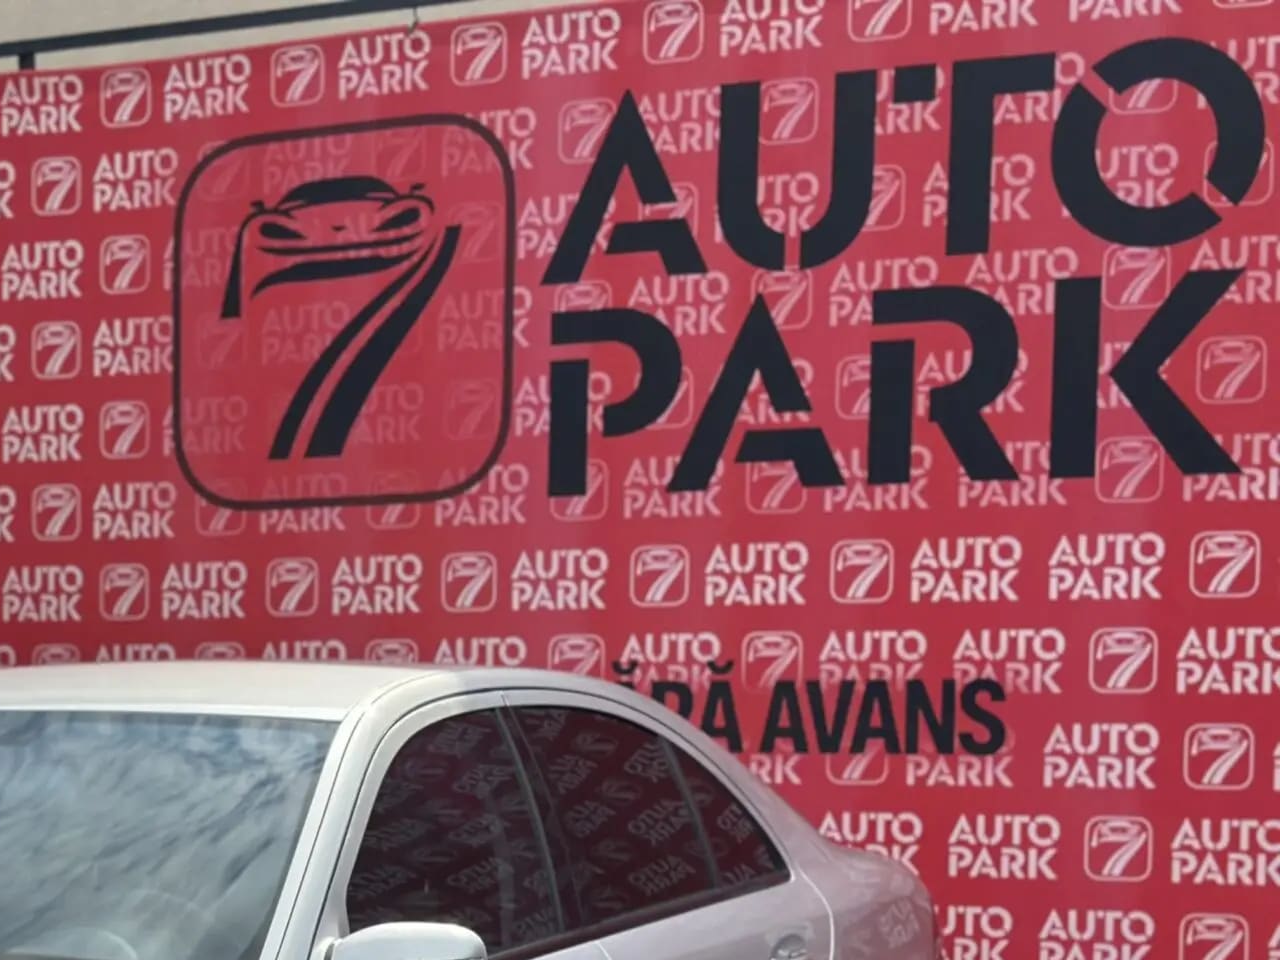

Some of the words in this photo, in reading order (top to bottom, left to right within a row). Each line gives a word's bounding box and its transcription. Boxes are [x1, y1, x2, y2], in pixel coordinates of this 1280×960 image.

[522, 5, 621, 46] AUTO
[929, 0, 1038, 35] PARK
[338, 27, 431, 67] AUTO
[721, 17, 821, 56] PARK
[163, 51, 251, 91] AUTO
[522, 39, 618, 79] PARK
[1, 71, 83, 105] AUTO
[339, 59, 428, 99] PARK
[164, 83, 248, 122] PARK
[1, 103, 81, 136] PARK
[93, 148, 177, 182] AUTO
[541, 37, 1266, 284] AUTO
[94, 179, 174, 212] PARK
[1, 240, 83, 272] AUTO
[965, 247, 1078, 284] AUTO
[2, 268, 80, 300] PARK
[629, 271, 729, 306] AUTO
[830, 256, 938, 294] AUTO
[93, 316, 172, 348] AUTO
[94, 346, 172, 376] PARK
[548, 269, 1244, 496] PARK
[2, 404, 83, 434] AUTO
[3, 433, 80, 462] PARK
[93, 483, 175, 511] AUTO
[824, 481, 928, 511] PARK
[958, 477, 1066, 508] PARK
[94, 511, 173, 539] PARK
[260, 504, 346, 533] PARK
[436, 497, 526, 527] PARK
[511, 548, 608, 580] AUTO
[705, 541, 808, 575] AUTO
[911, 536, 1022, 570] AUTO
[1049, 532, 1165, 567] AUTO
[3, 566, 83, 593] AUTO
[162, 562, 247, 590] AUTO
[332, 554, 422, 585] AUTO
[911, 569, 1018, 602] PARK
[1049, 566, 1161, 600] PARK
[163, 590, 244, 619] PARK
[332, 584, 419, 614] PARK
[512, 579, 605, 611] PARK
[705, 573, 805, 606] PARK
[3, 594, 80, 620] PARK
[434, 637, 527, 667] AUTO
[620, 632, 721, 664] AUTO
[820, 630, 928, 662] AUTO
[953, 628, 1065, 662] AUTO
[761, 679, 1007, 756] AVANS
[1044, 723, 1159, 755] AUTO
[906, 754, 1015, 789] PARK
[1044, 756, 1155, 789] PARK
[820, 811, 923, 843] AUTO
[949, 814, 1060, 846] AUTO
[1171, 819, 1280, 852] AUTO
[949, 846, 1056, 879] PARK
[1171, 851, 1280, 886] PARK
[1039, 910, 1154, 943] AUTO
